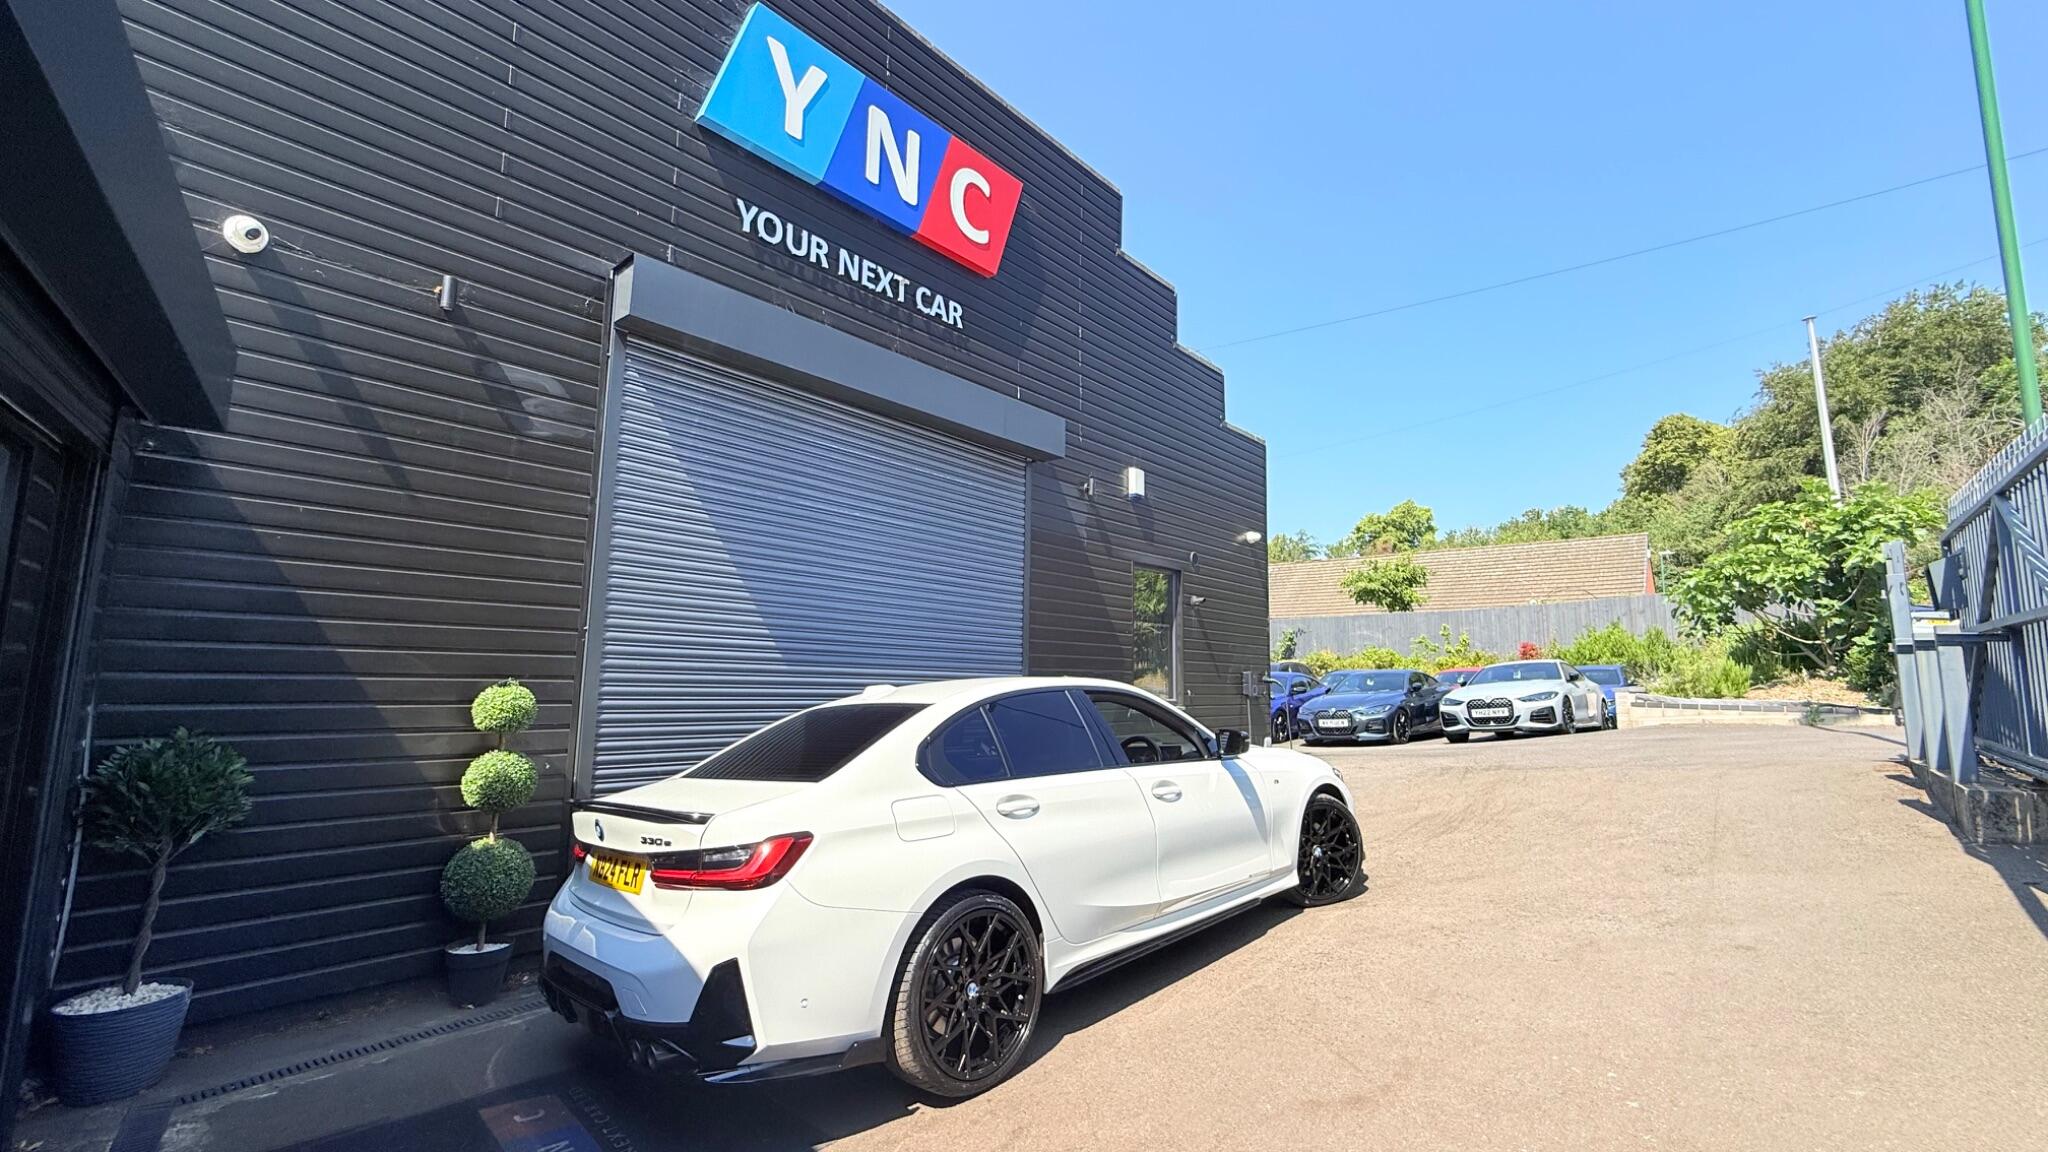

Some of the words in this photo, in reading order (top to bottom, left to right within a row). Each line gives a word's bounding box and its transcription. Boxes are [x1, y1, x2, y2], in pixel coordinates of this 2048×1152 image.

[766, 35, 991, 245] YNC
[736, 197, 829, 269] YOUR
[838, 247, 910, 303] NEXT
[915, 286, 963, 329] CAR
